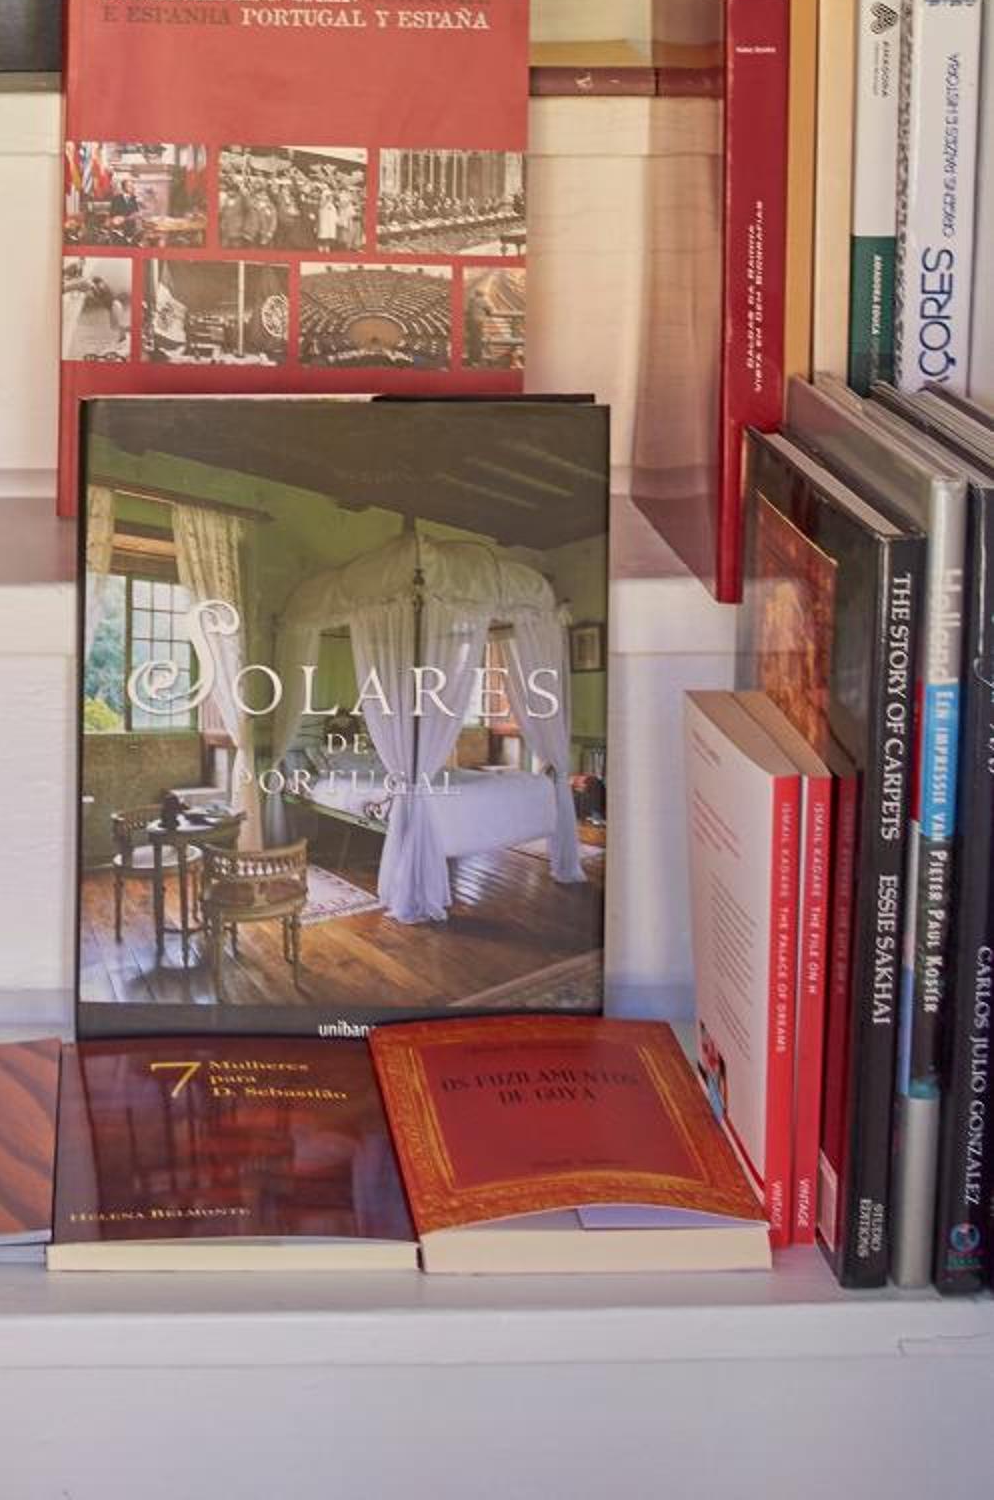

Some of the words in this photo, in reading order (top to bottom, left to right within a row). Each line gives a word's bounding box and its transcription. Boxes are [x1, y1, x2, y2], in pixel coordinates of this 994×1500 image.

[101, 5, 119, 22] E
[125, 6, 231, 25] ESPANHA
[240, 7, 366, 28] PORTUGAL
[375, 9, 391, 28] Y
[398, 7, 490, 29] ESPAÑA
[916, 245, 957, 393] ÇORES
[889, 573, 911, 622] THE
[126, 598, 561, 720] SOLARES
[886, 625, 908, 698] STORY
[884, 702, 905, 729] OF
[326, 733, 369, 755] DE
[239, 768, 462, 796] PORTUGAL
[879, 736, 903, 841] CARPETS
[810, 905, 821, 925] THE
[875, 874, 897, 932] ESSIE
[926, 908, 946, 946] PAUL
[808, 961, 819, 981] ON
[871, 934, 894, 1025] SAKHAI
[972, 946, 994, 1028] CARLOS
[777, 982, 787, 998] OF
[318, 1019, 377, 1038] uniban
[150, 1061, 202, 1098] 7
[209, 1060, 309, 1071] Mulheres
[210, 1075, 257, 1085] para
[967, 1036, 988, 1092] JULIO
[210, 1087, 236, 1097] D.
[245, 1087, 349, 1100] Sebastião
[963, 1099, 985, 1204] GONZALEZ
